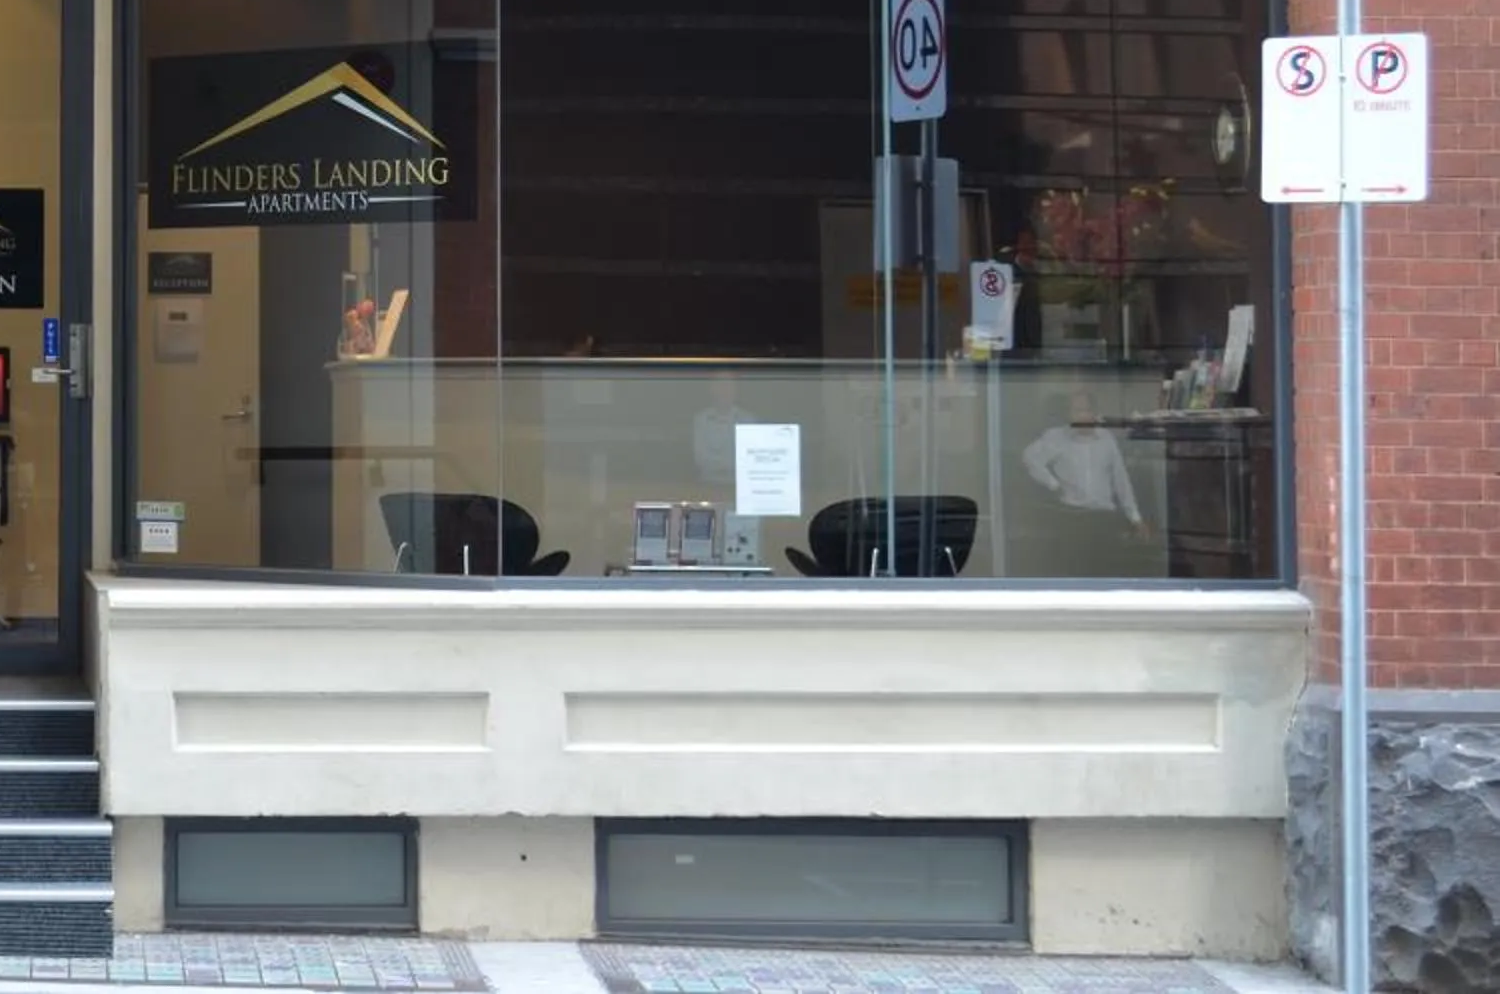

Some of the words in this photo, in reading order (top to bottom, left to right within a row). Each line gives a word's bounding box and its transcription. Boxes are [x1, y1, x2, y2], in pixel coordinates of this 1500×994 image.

[1371, 50, 1399, 89] P
[171, 163, 301, 194] FLINDERS
[313, 157, 450, 188] LANDING
[247, 190, 369, 214] APARTMENTS
